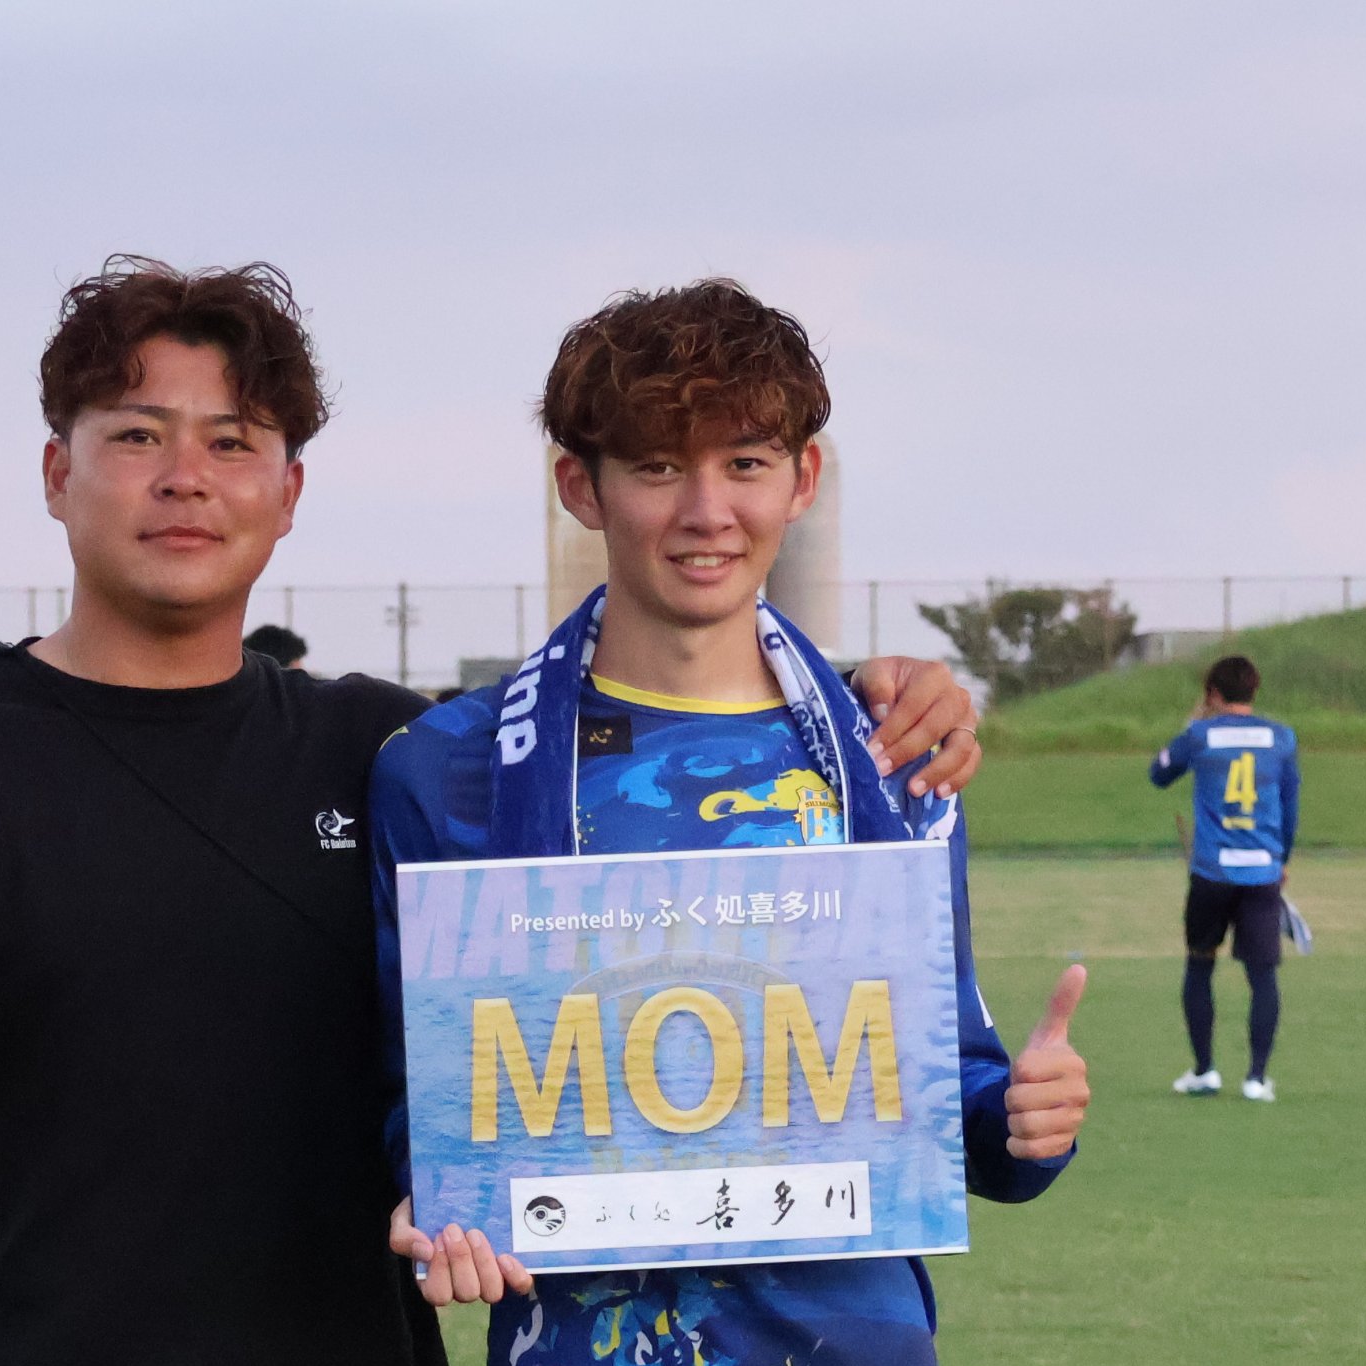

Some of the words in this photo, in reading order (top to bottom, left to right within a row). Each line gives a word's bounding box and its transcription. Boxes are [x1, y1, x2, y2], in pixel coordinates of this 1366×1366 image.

[1224, 752, 1258, 813] 4
[511, 908, 614, 932] Presented
[620, 907, 645, 931] by
[651, 889, 842, 927] ふく処喜多川
[471, 979, 902, 1142] MOM
